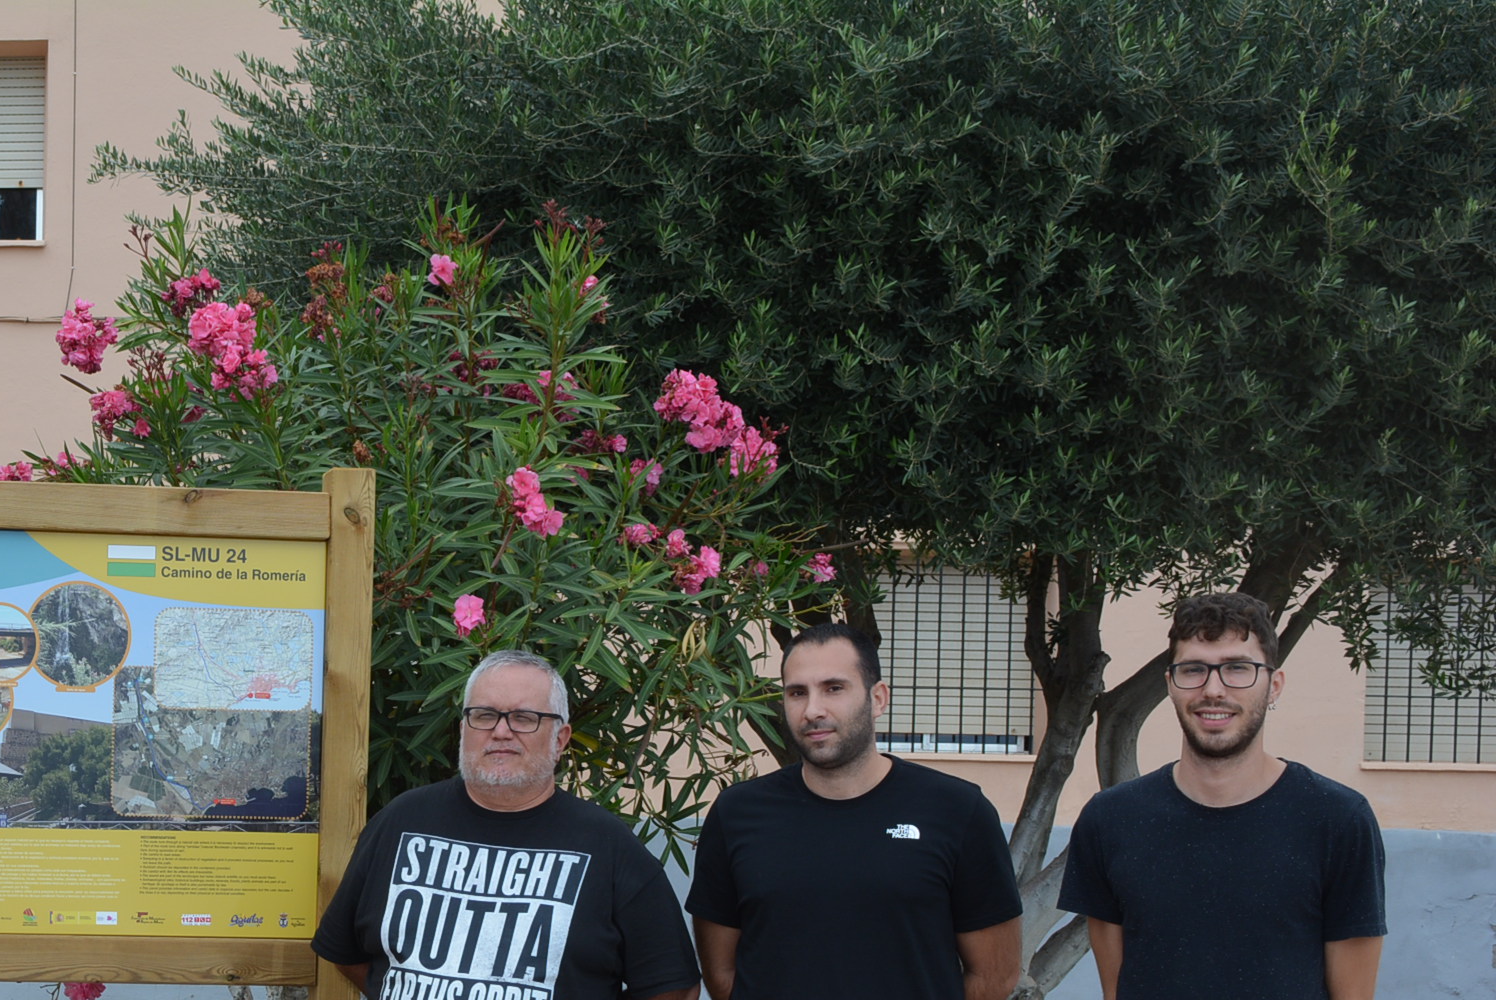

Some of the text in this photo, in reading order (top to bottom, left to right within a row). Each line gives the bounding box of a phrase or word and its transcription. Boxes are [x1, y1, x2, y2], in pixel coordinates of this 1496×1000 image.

[161, 545, 247, 564] SL-MU 24
[161, 565, 306, 582] Camino de la Romería
[400, 836, 581, 900] STRAIGHT
[387, 888, 555, 984] OUTTA
